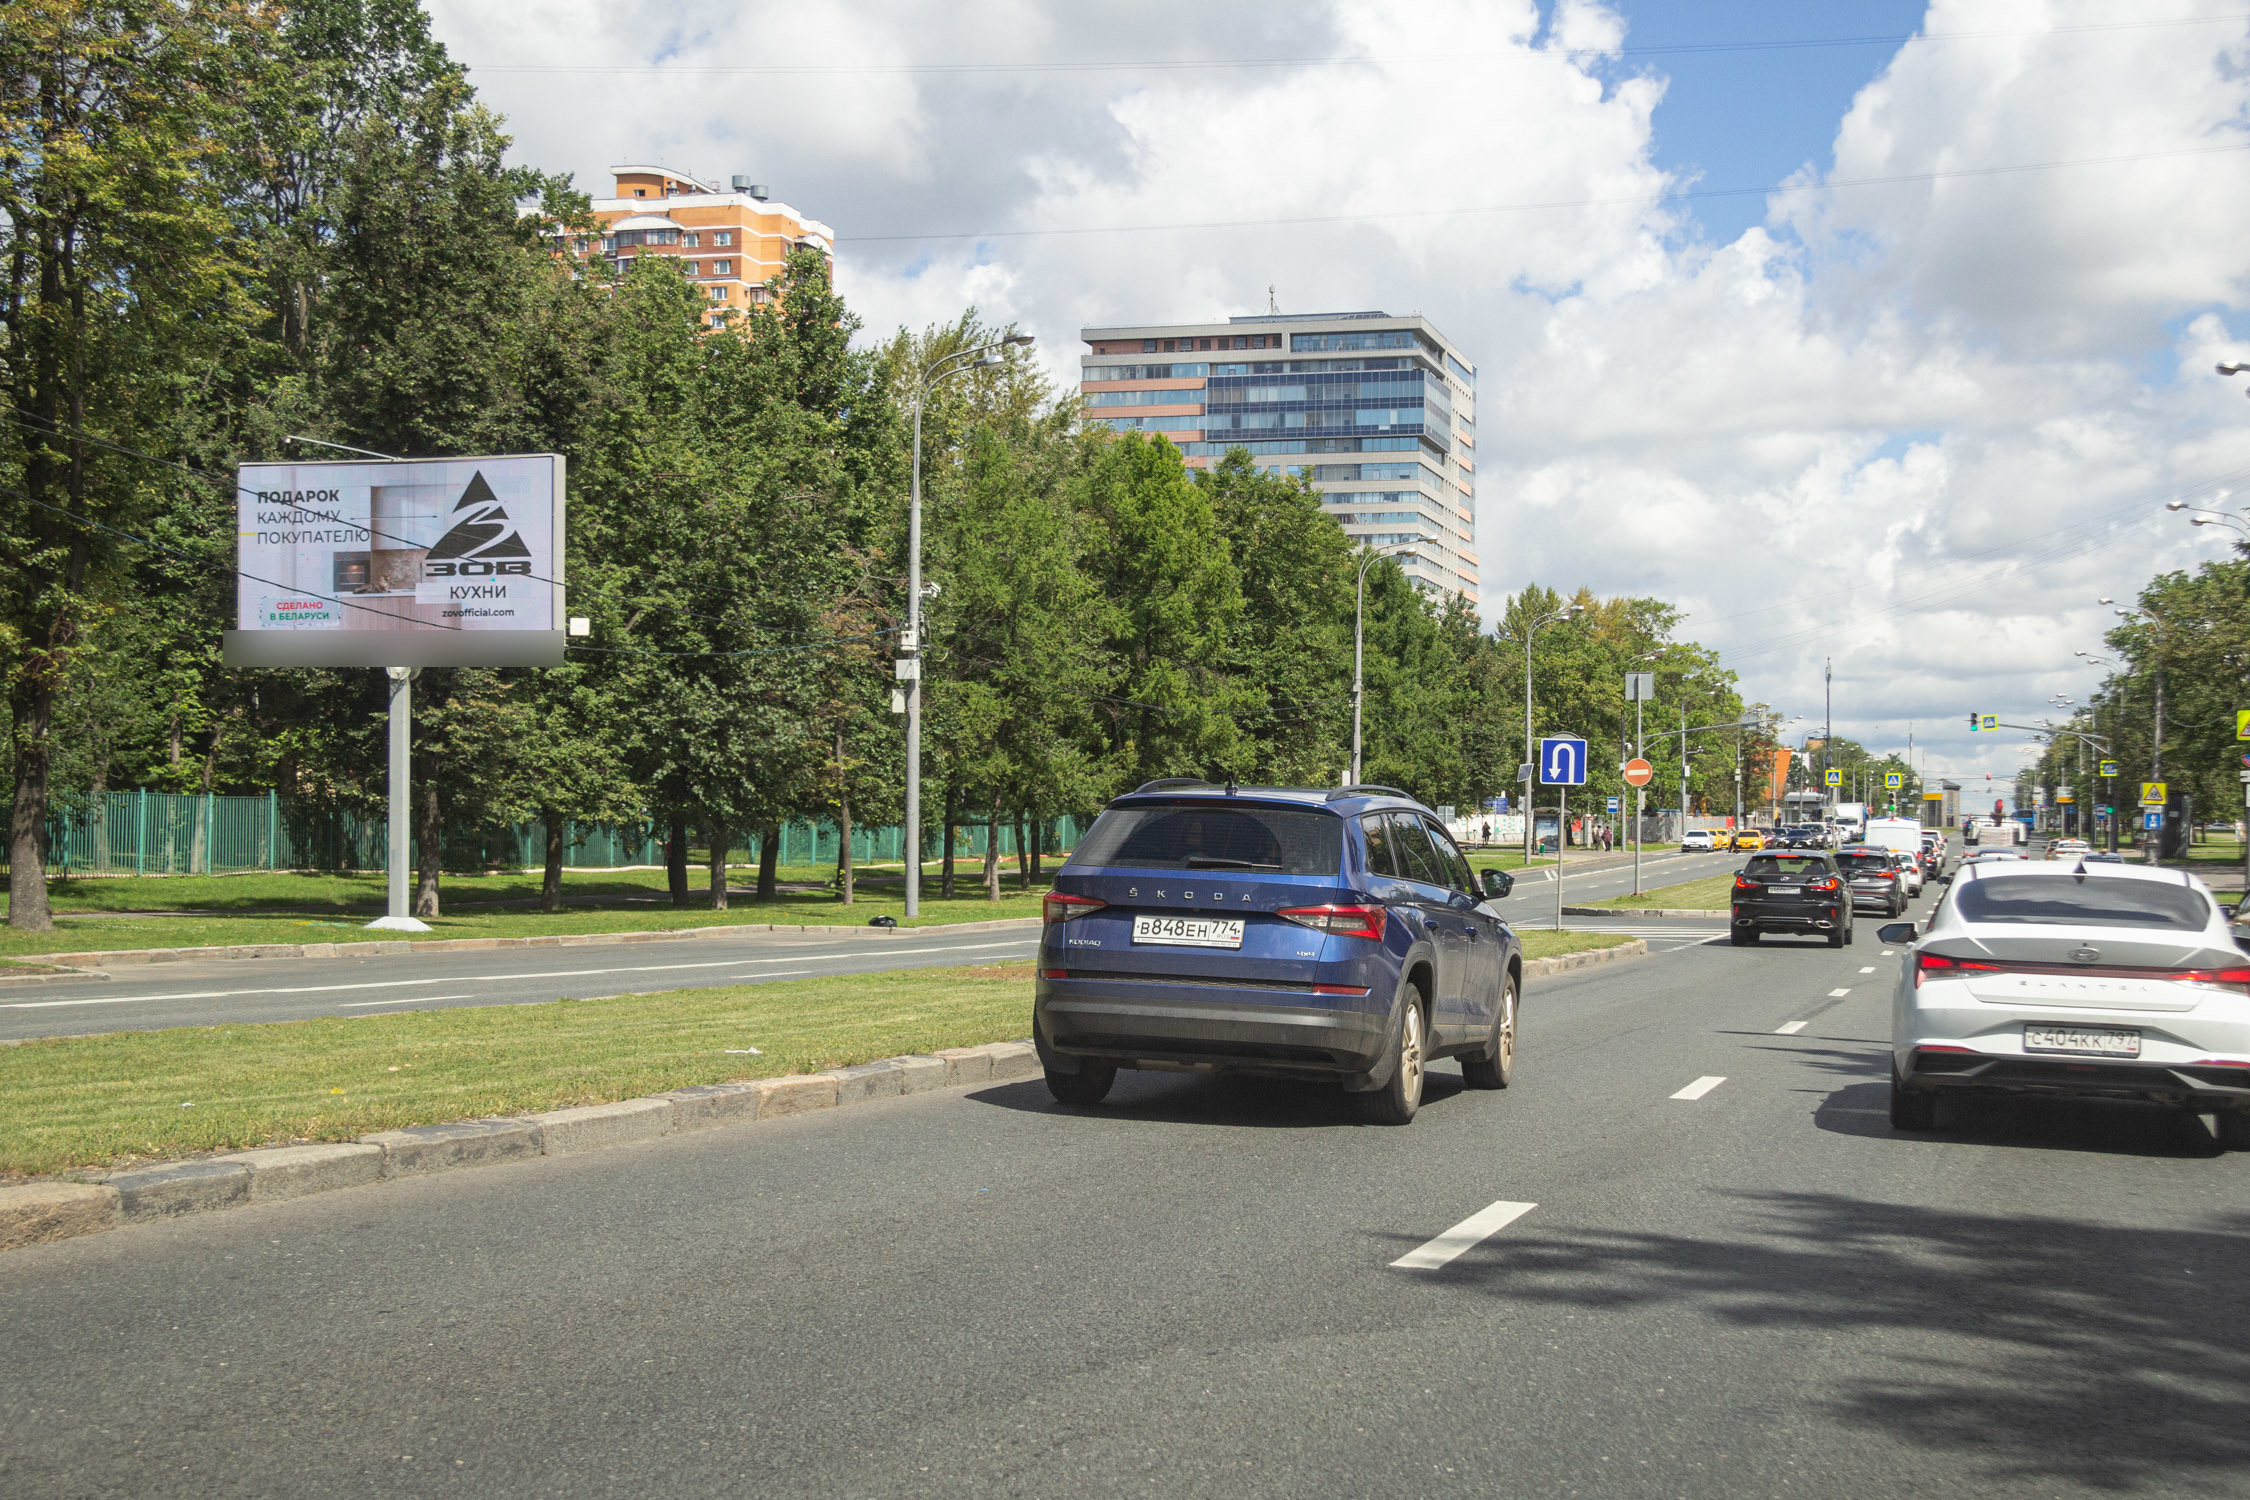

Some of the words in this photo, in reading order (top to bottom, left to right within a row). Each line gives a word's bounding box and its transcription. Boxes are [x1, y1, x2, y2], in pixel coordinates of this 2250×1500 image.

[257, 489, 340, 504] ПОДАРОК
[257, 510, 341, 525] КАЖДОМУ
[257, 529, 370, 544] ПОКУПАТЕЛЮ
[425, 561, 532, 577] ЗОВ
[450, 585, 506, 599] КУХНИ
[276, 601, 323, 611] СДЕЛАНО
[442, 607, 515, 618] zovofficial.com
[270, 613, 276, 621] В
[279, 612, 329, 621] БЕЛАРУСИ
[1129, 887, 1252, 902] ŠKODA
[1068, 939, 1101, 948] KODIAQ
